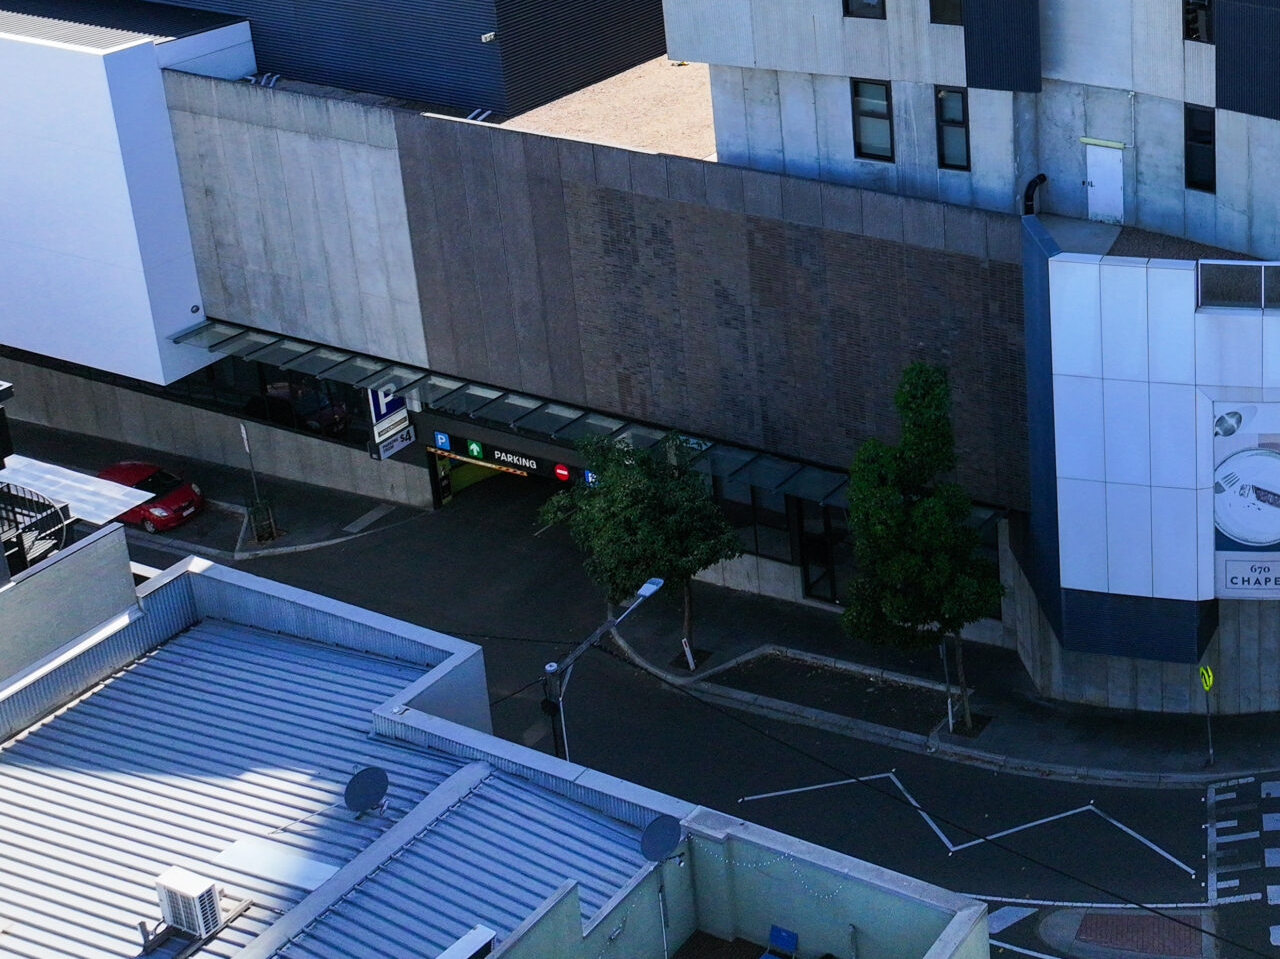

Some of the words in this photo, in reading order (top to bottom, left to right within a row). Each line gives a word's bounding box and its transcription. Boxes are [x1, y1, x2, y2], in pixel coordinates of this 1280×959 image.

[378, 383, 396, 415] P
[437, 434, 446, 445] P
[494, 451, 537, 469] PARKING
[1250, 565, 1270, 573] 670
